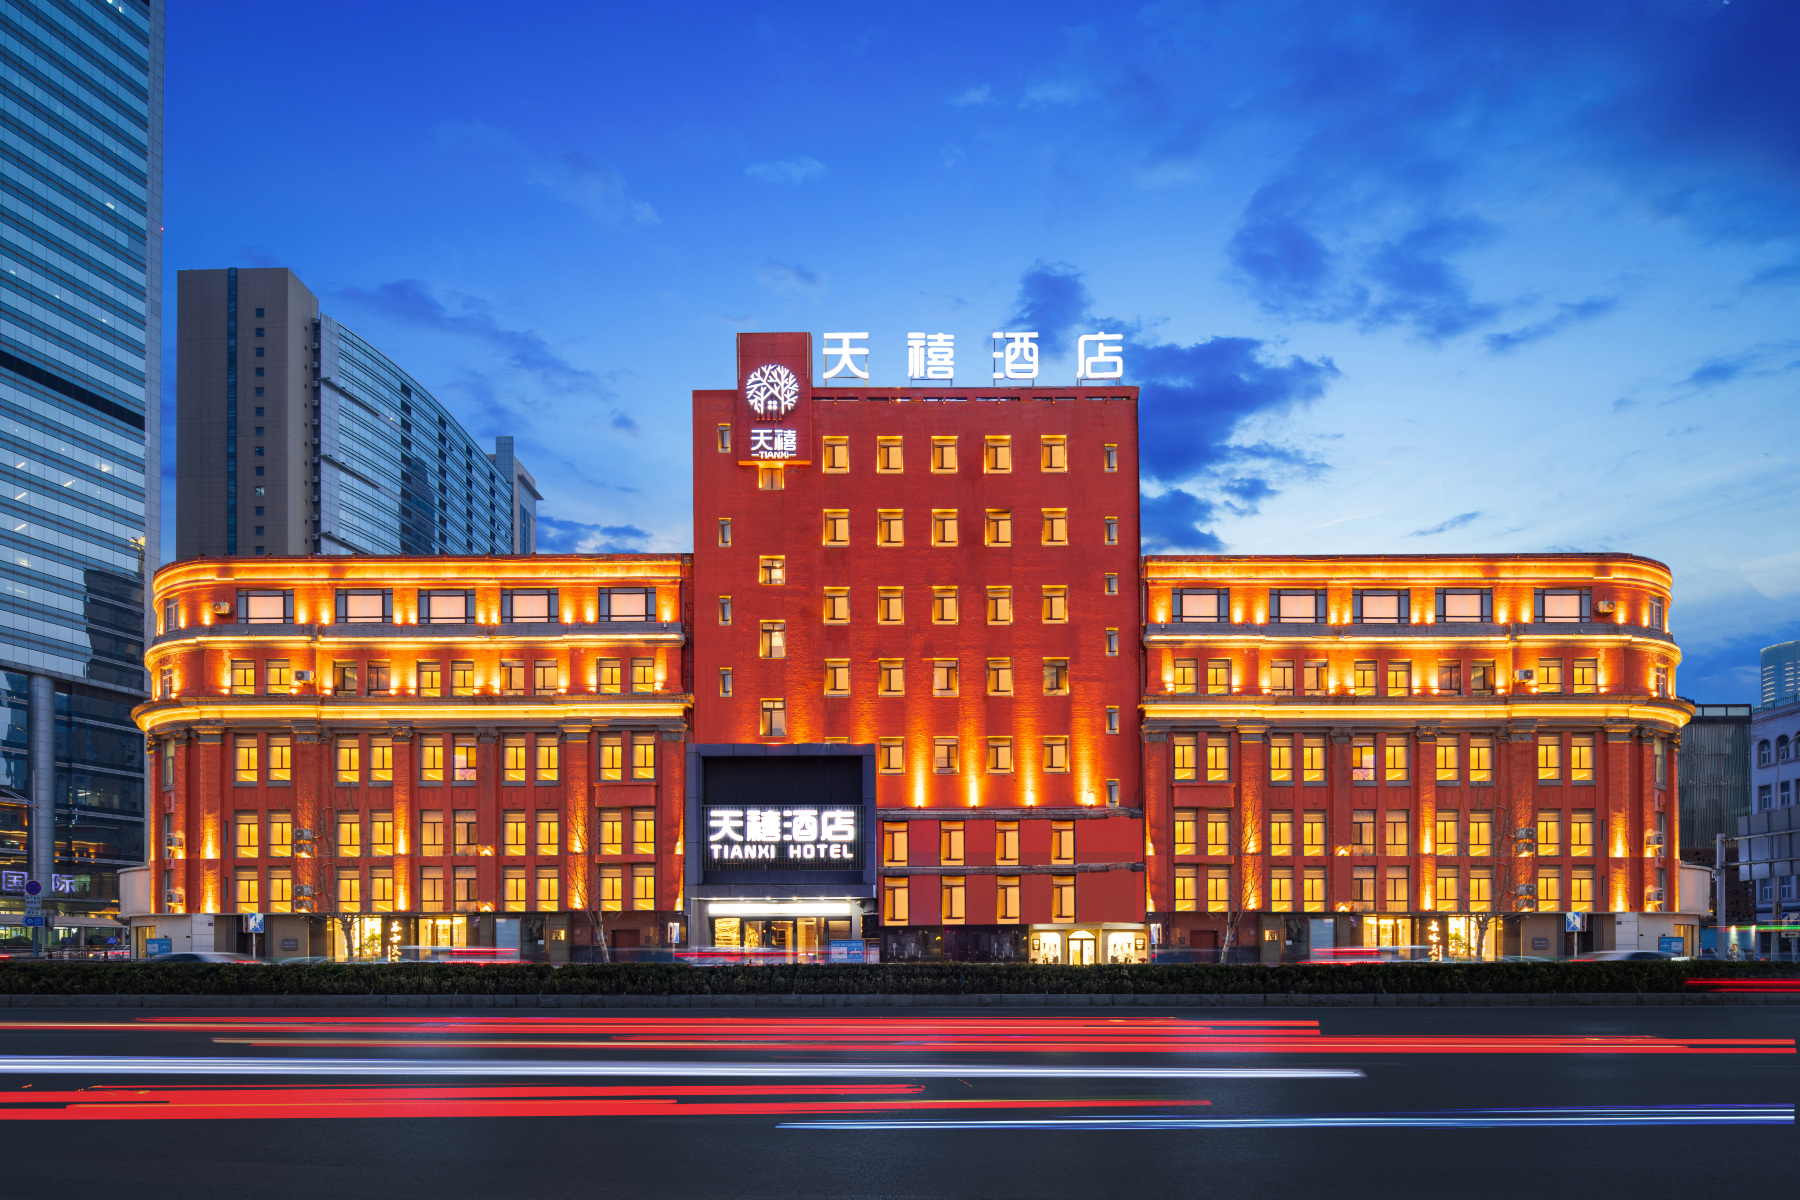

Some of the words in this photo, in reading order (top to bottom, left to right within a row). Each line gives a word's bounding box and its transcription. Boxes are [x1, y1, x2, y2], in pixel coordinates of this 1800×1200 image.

[822, 331, 1123, 379] 天禧酒店
[750, 429, 797, 451] 天禧
[759, 450, 789, 459] TIANXI
[709, 810, 855, 842] 天禧酒店
[710, 844, 776, 859] TIANXI
[789, 844, 854, 859] HOTEL
[2, 870, 76, 894] 国际
